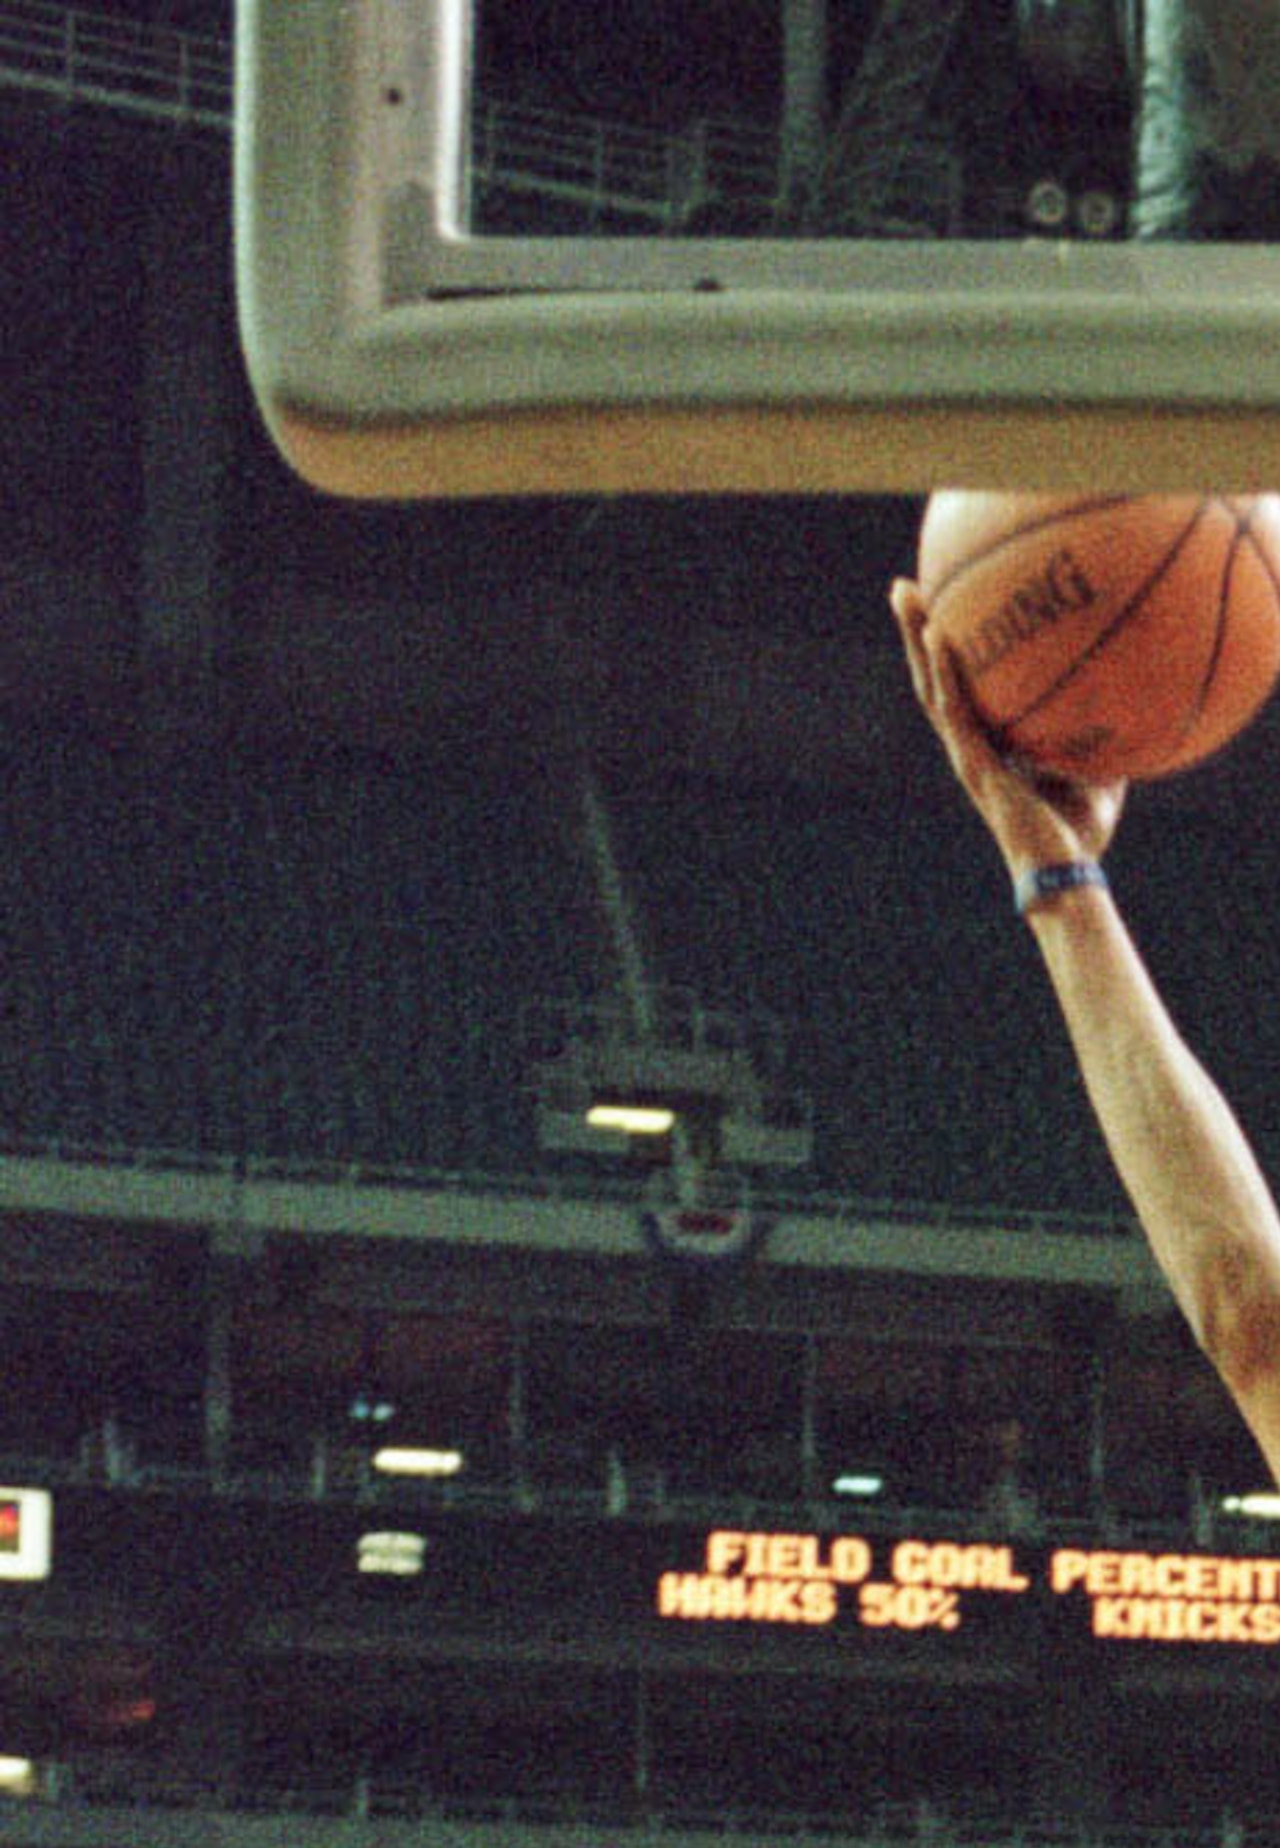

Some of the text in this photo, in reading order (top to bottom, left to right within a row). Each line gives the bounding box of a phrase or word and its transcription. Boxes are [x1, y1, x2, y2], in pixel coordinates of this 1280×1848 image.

[706, 1530, 873, 1583] FIELD
[892, 1540, 1029, 1593] GOAL
[659, 1571, 838, 1625] HAWKS
[859, 1583, 961, 1629] 50%
